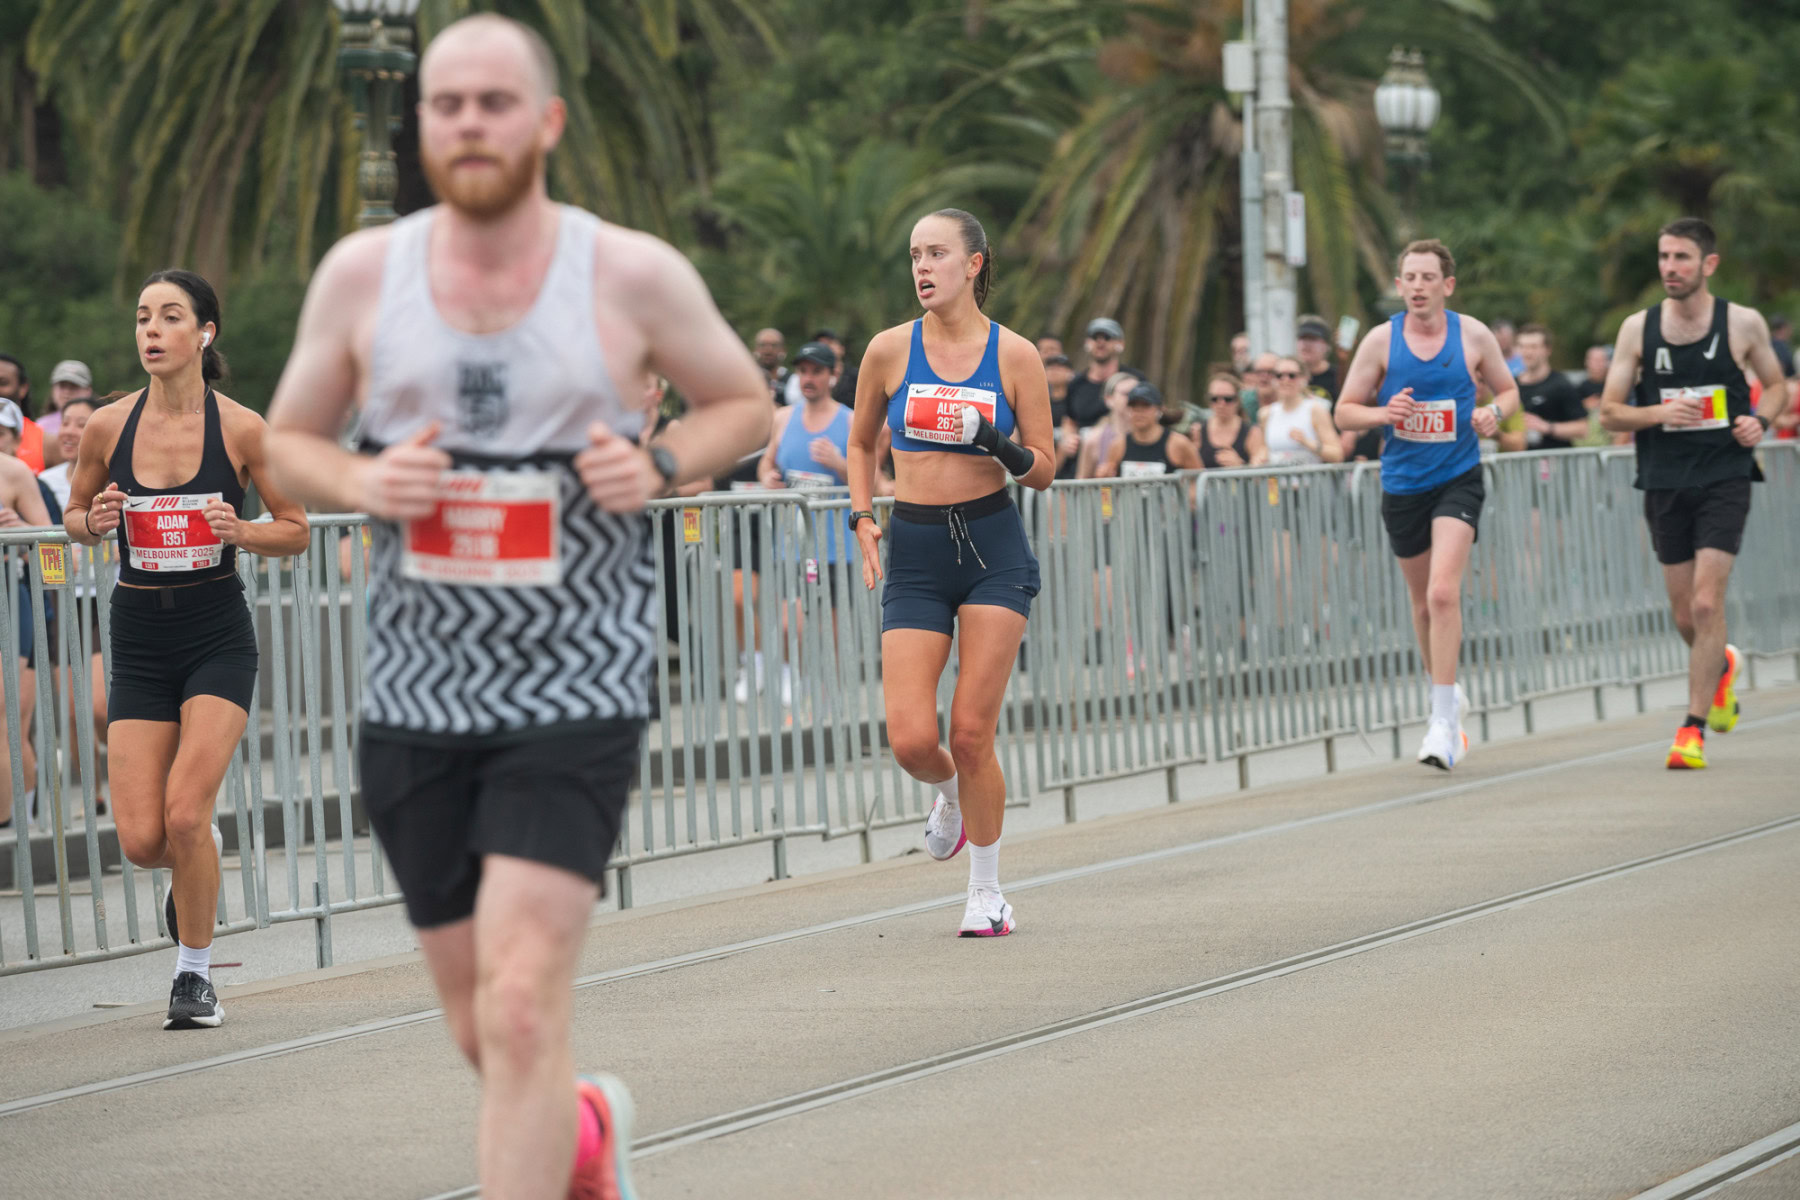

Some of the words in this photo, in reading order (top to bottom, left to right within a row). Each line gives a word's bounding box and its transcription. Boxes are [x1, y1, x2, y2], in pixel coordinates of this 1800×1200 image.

[937, 402, 959, 416] ALIC
[937, 416, 955, 430] 267
[913, 429, 956, 442] MELBOURN
[157, 514, 189, 530] ADAM
[162, 531, 187, 546] 1351
[136, 549, 188, 559] MELBOURNE
[192, 546, 215, 557] 2025
